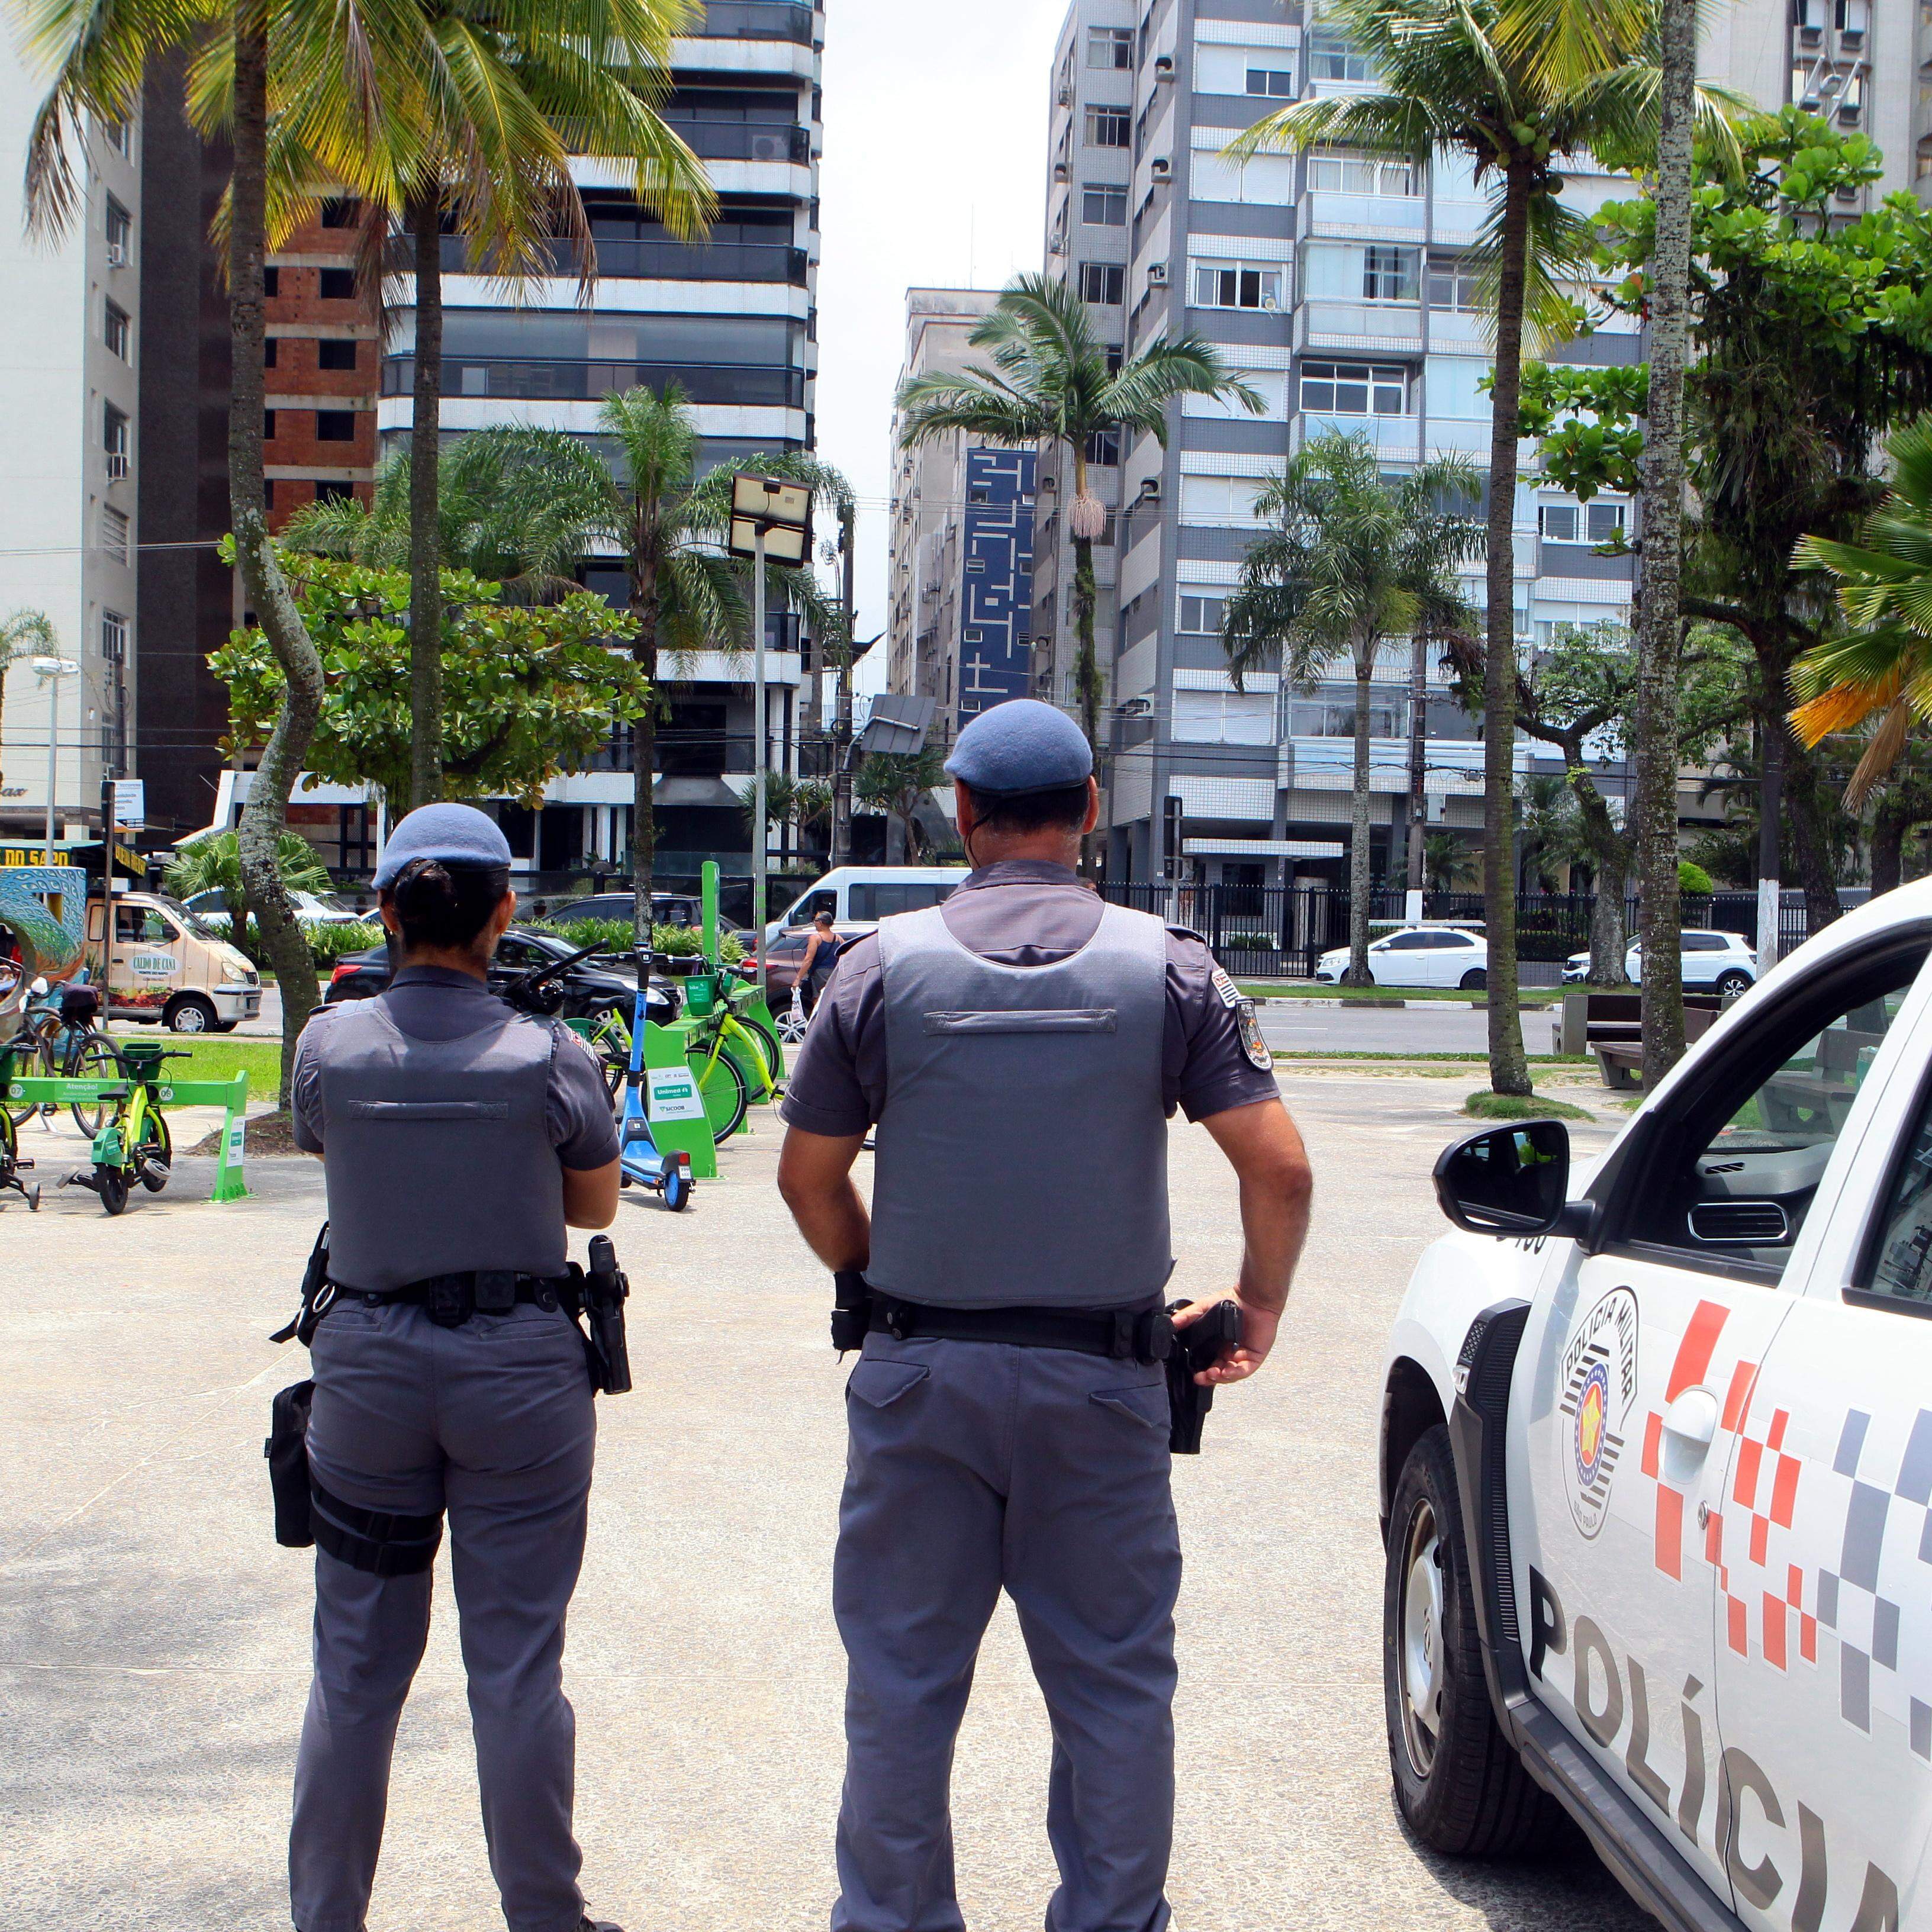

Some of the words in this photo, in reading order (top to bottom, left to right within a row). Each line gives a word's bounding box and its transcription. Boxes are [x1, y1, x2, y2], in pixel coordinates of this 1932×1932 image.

[133, 957, 152, 969] CALDO
[153, 957, 161, 970] DE
[162, 958, 176, 971] CANA
[1614, 1299, 1633, 1407] MILITAR
